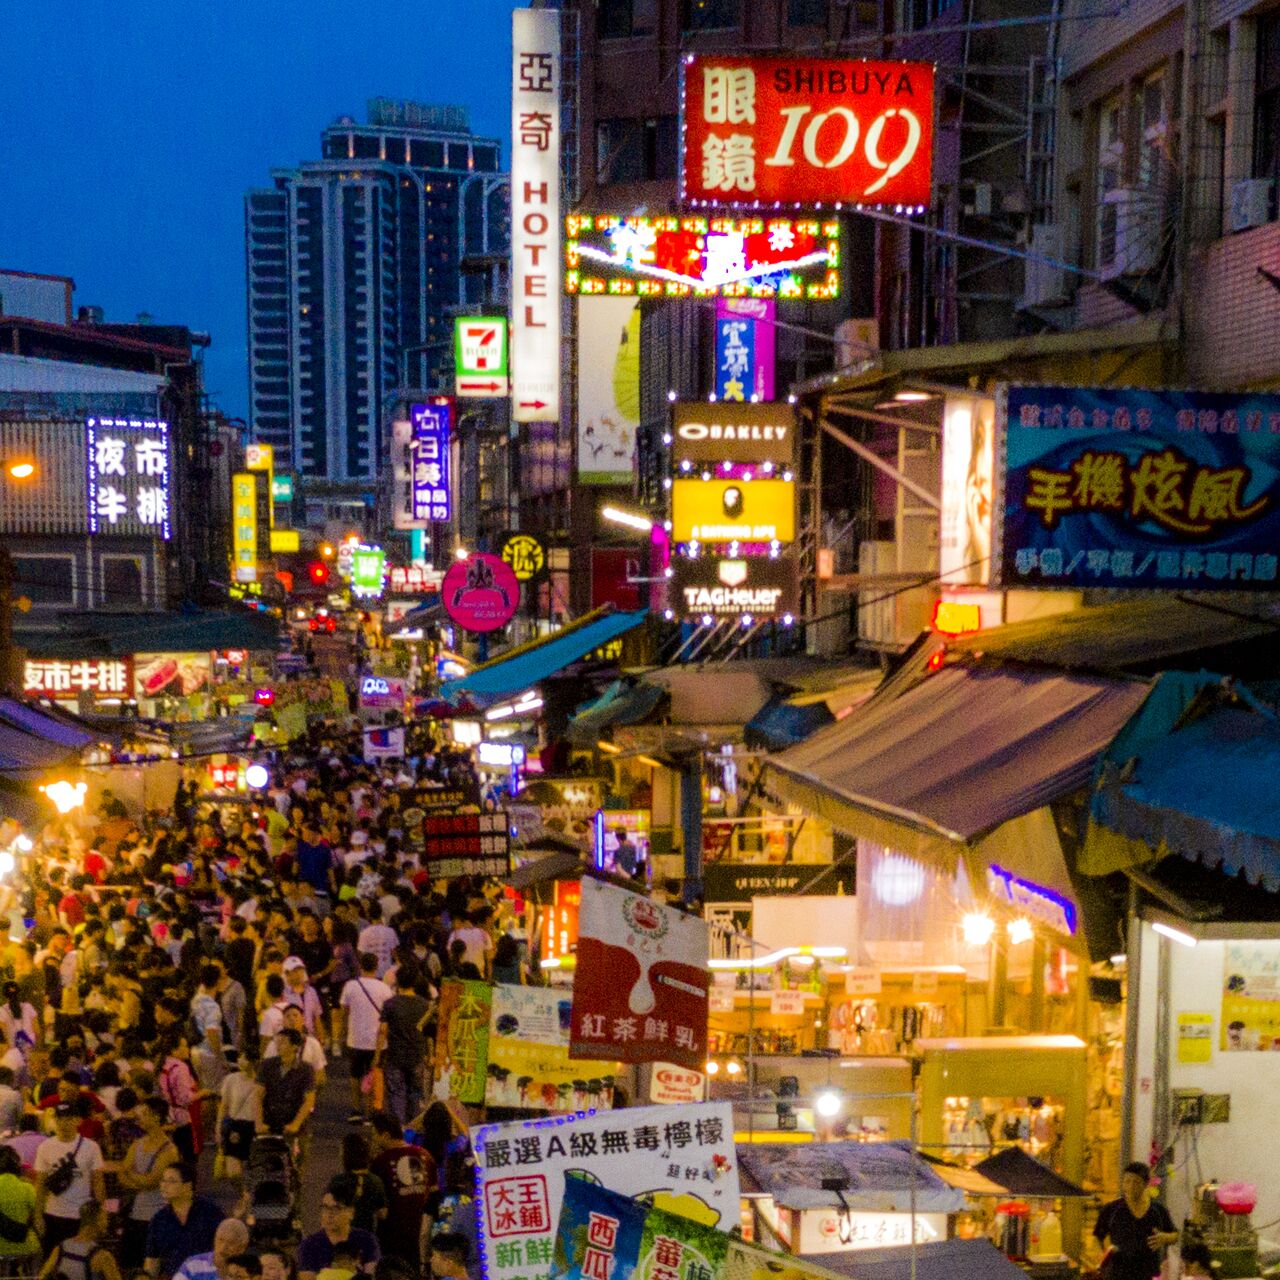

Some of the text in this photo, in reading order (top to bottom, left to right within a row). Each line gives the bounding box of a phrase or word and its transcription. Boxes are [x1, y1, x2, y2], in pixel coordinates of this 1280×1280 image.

[519, 51, 552, 152] 亞奇
[773, 66, 913, 96] SHIBUYA
[701, 66, 756, 193] 眼鏡
[764, 105, 921, 195] 109
[523, 181, 548, 329] HOTEL
[96, 438, 165, 475] 夜市
[415, 409, 441, 487] 向日葵
[96, 488, 165, 524] 牛排
[580, 1012, 698, 1050] 紅茶鮮乳
[484, 1117, 724, 1168] 嚴選A級無毒檸檬
[495, 1237, 553, 1269] 新鮮
